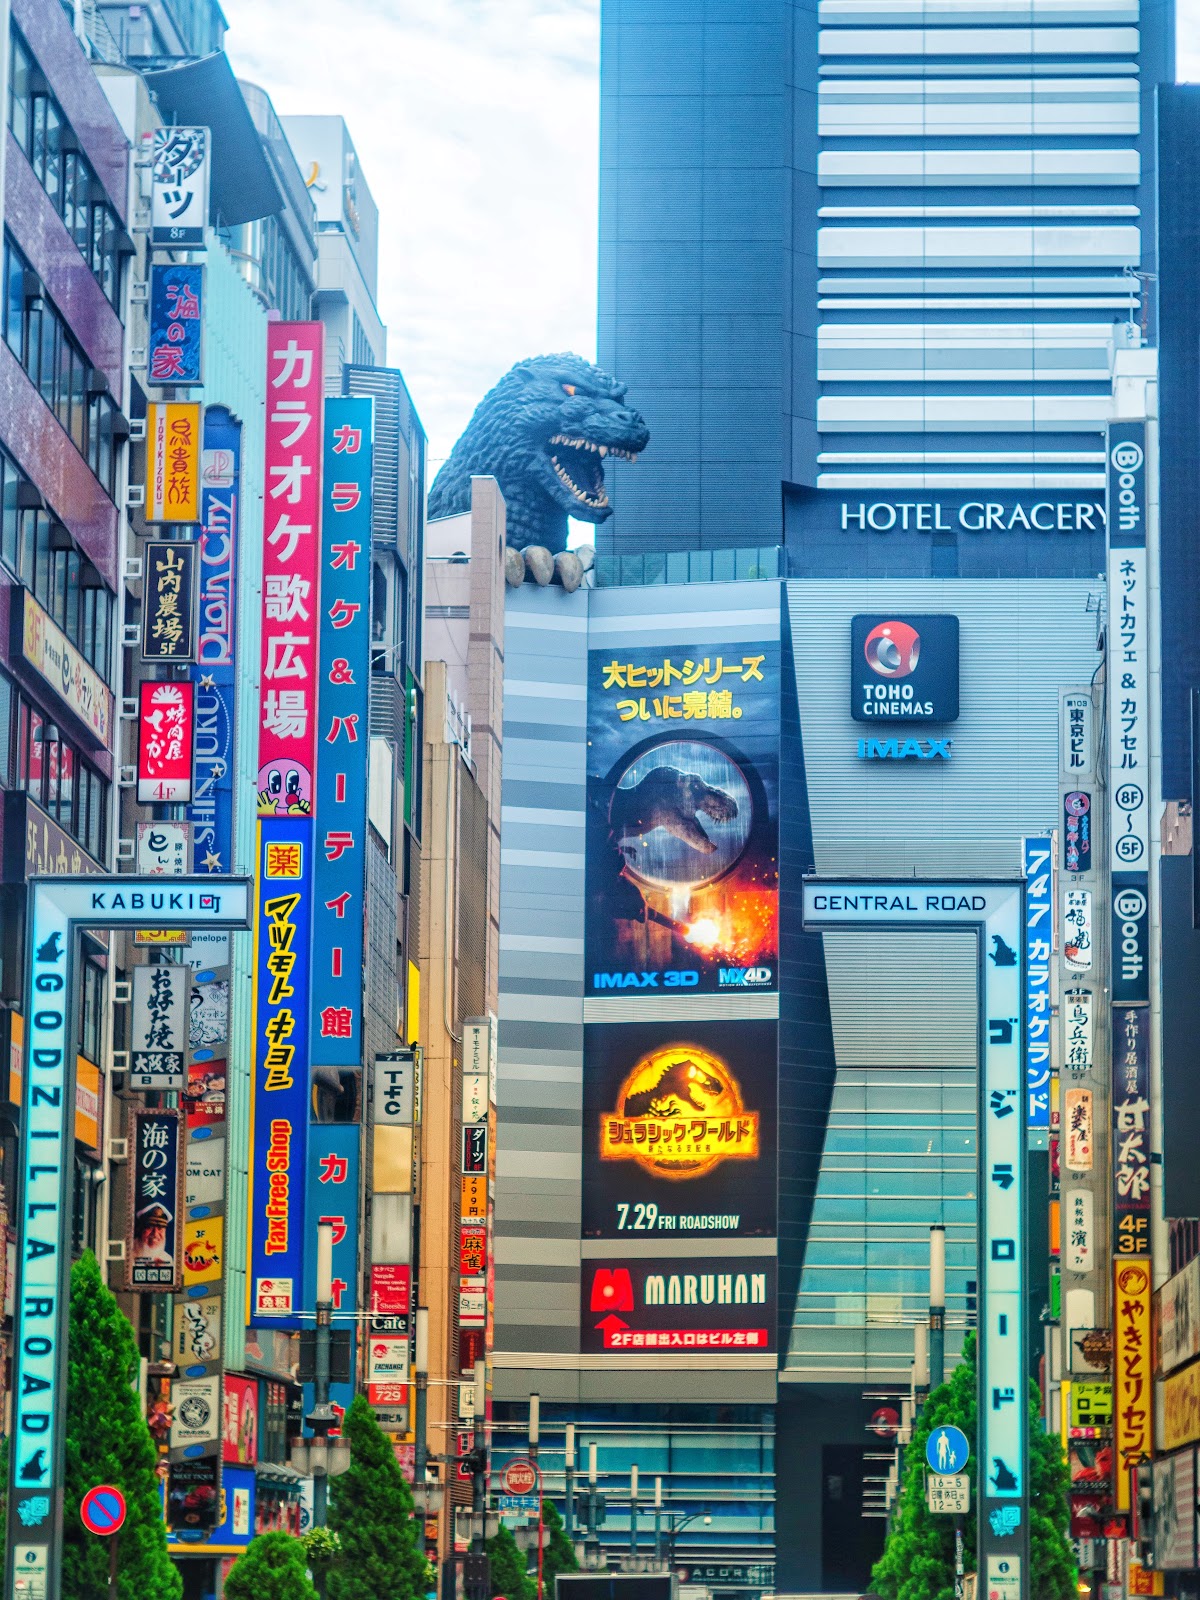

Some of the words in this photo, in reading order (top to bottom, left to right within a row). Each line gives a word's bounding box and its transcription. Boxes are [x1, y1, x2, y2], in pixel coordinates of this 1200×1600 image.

[165, 135, 196, 219] ダーツ
[171, 228, 186, 239] 8F
[151, 285, 200, 378] 海の家
[1111, 441, 1144, 530] Booth
[841, 502, 952, 530] HOTEL
[262, 339, 314, 739] カラオケ歌広場
[152, 548, 184, 642] 山内農場
[160, 643, 176, 655] 5F
[602, 655, 765, 689] 大ヒットシリーズ
[616, 690, 743, 721] ついに完結。
[863, 685, 914, 699] TOHO
[863, 702, 934, 714] CINEMAS
[857, 737, 953, 759] IMAX
[1070, 709, 1084, 767] 東京ビル
[152, 782, 176, 799] 4F
[268, 846, 299, 875] 薬
[814, 896, 918, 911] CENTRAL
[926, 896, 986, 911] ROAD
[1113, 889, 1147, 980] Booth
[264, 893, 301, 1092] マツモトキヨシ
[594, 972, 661, 988] IMAX
[663, 970, 699, 987] 3D
[719, 967, 772, 985] MX4D
[145, 968, 174, 1049] お好み焼
[1124, 1010, 1138, 1094] 手作り居酒屋
[27, 973, 64, 1261] GODZILLA
[142, 1122, 169, 1199] 海の家
[266, 1118, 292, 1172] Shop
[473, 1129, 484, 1162] ダーツ
[1114, 1097, 1150, 1200] 甘太郎
[203, 1169, 221, 1177] CAT
[266, 1172, 289, 1218] Free
[617, 1203, 658, 1230] 7.29
[658, 1215, 676, 1229] FRI
[679, 1215, 740, 1229] ROADSHOW
[988, 1018, 1019, 1411] ゴジラロード
[1119, 1214, 1147, 1232] 4F
[265, 1218, 288, 1255] Tax
[463, 1236, 482, 1268] 麻雀
[1119, 1235, 1147, 1252] 3F
[645, 1274, 766, 1305] MARUHAN
[21, 1297, 54, 1433] ROAD
[376, 1391, 401, 1402] 729
